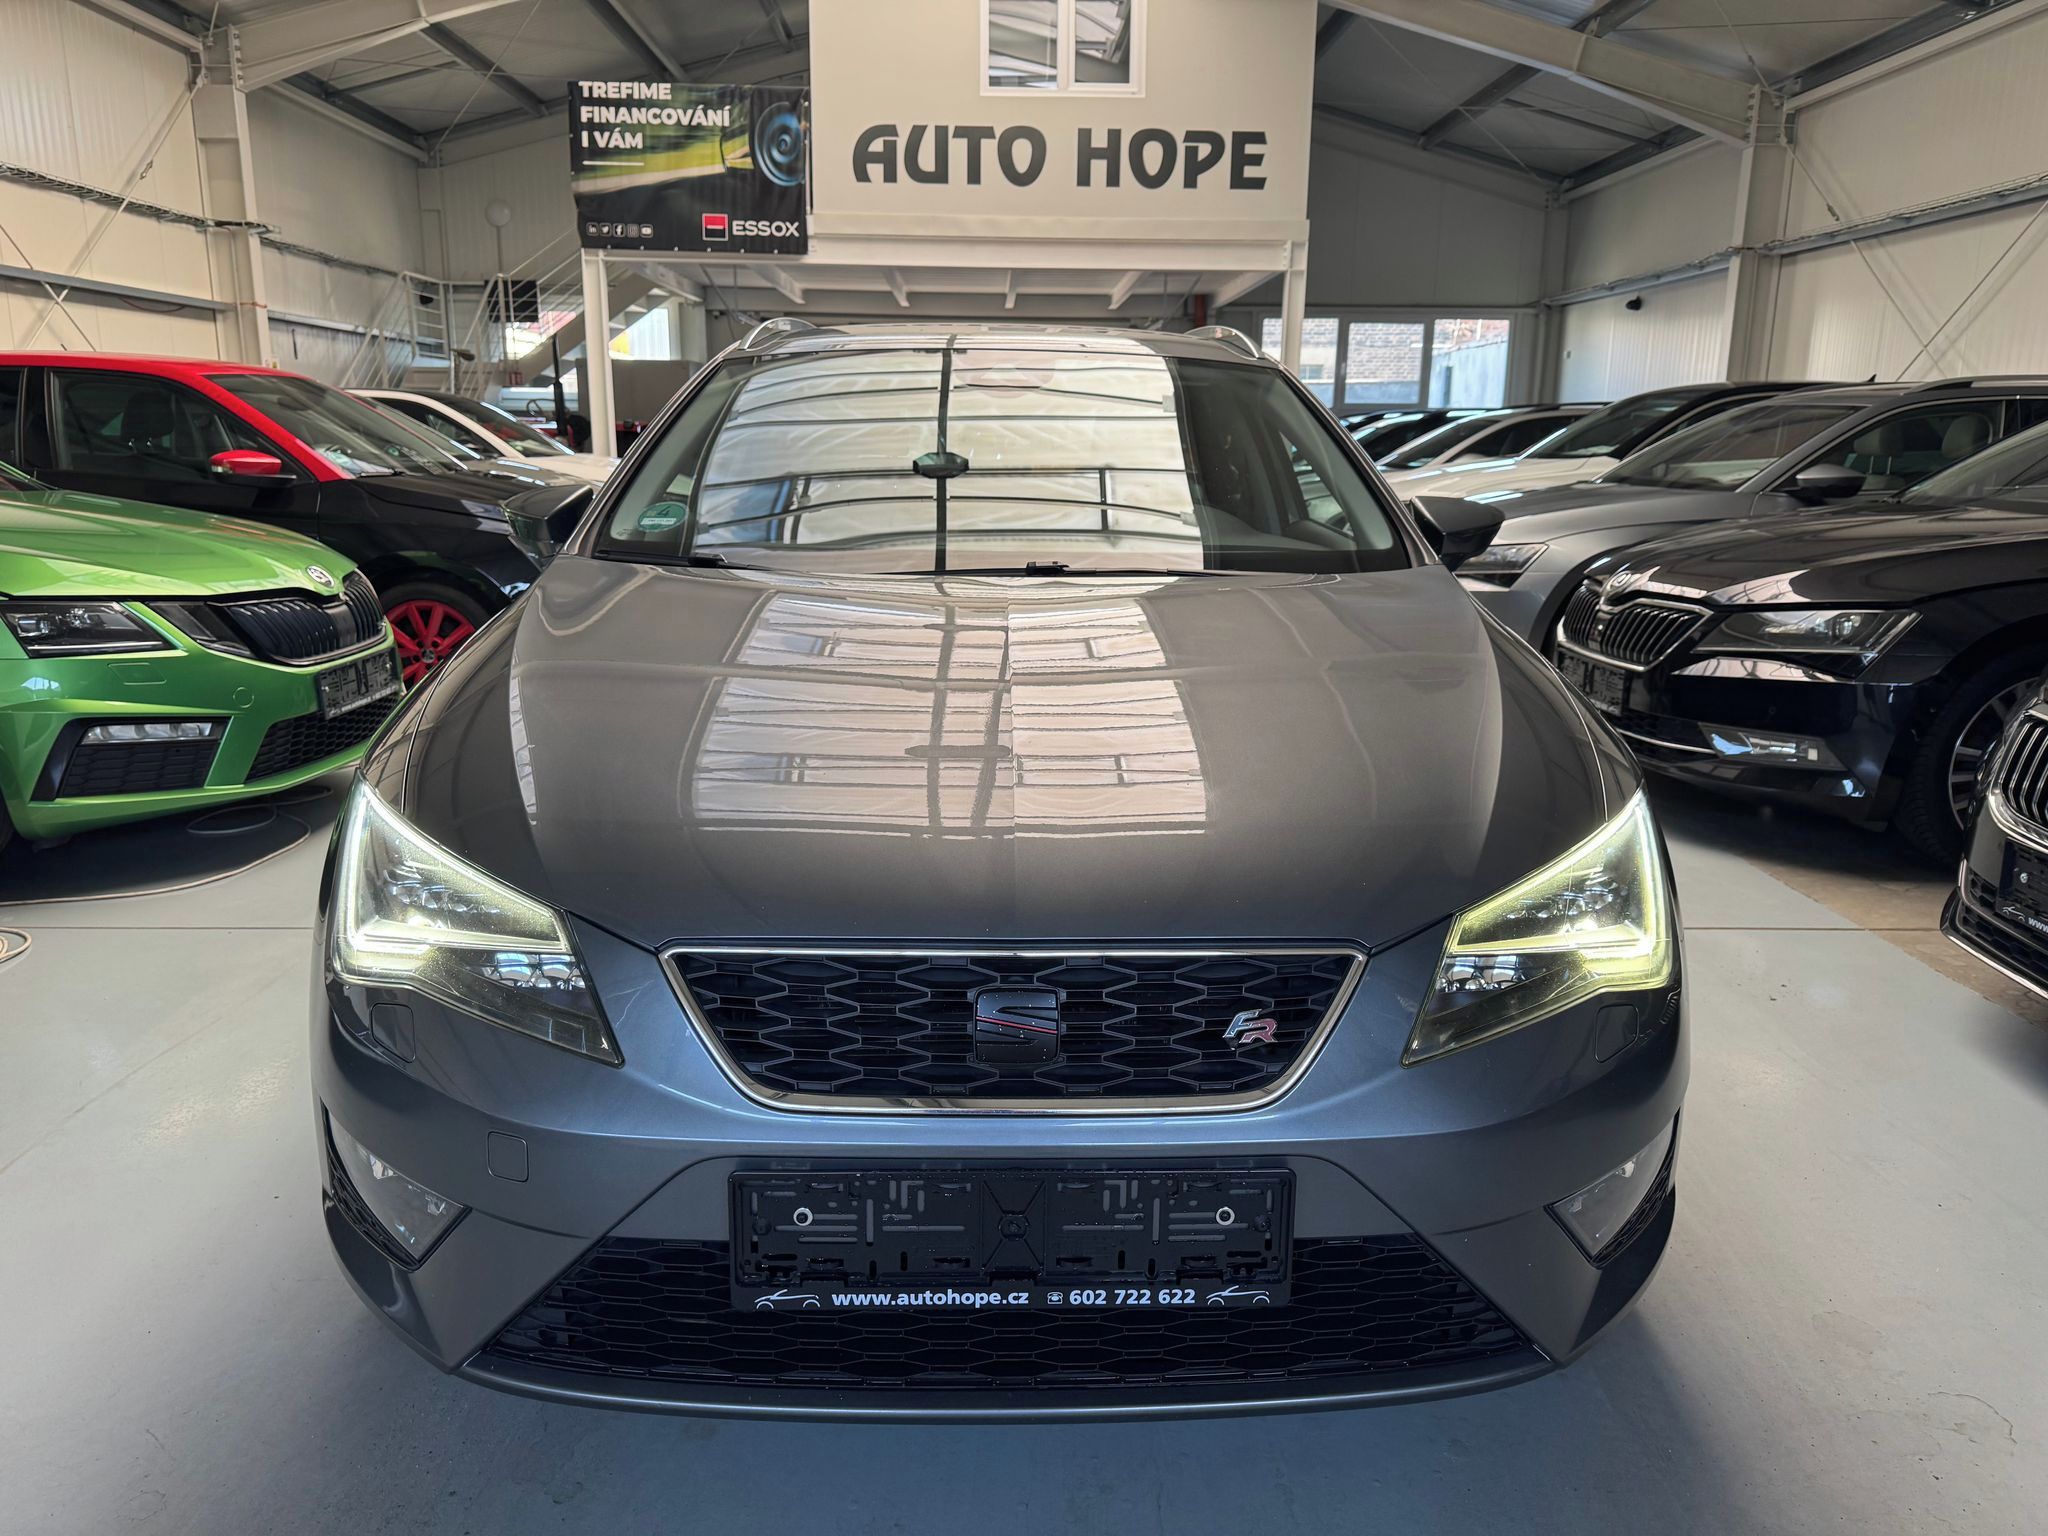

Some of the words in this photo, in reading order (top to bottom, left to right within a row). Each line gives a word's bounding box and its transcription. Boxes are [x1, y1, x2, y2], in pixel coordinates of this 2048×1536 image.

[578, 81, 672, 100] TREFIME
[580, 104, 732, 127] FINANCOVÁNÍ
[581, 130, 589, 148] I
[593, 127, 643, 149] VÁM
[852, 124, 1047, 187] AUTO
[1076, 128, 1268, 190] HOPE
[732, 220, 800, 238] ESSOX
[831, 1288, 1029, 1309] www.autohope.cz
[1069, 1289, 1107, 1305] 602
[1114, 1289, 1151, 1305] 722
[1158, 1288, 1196, 1304] 622
